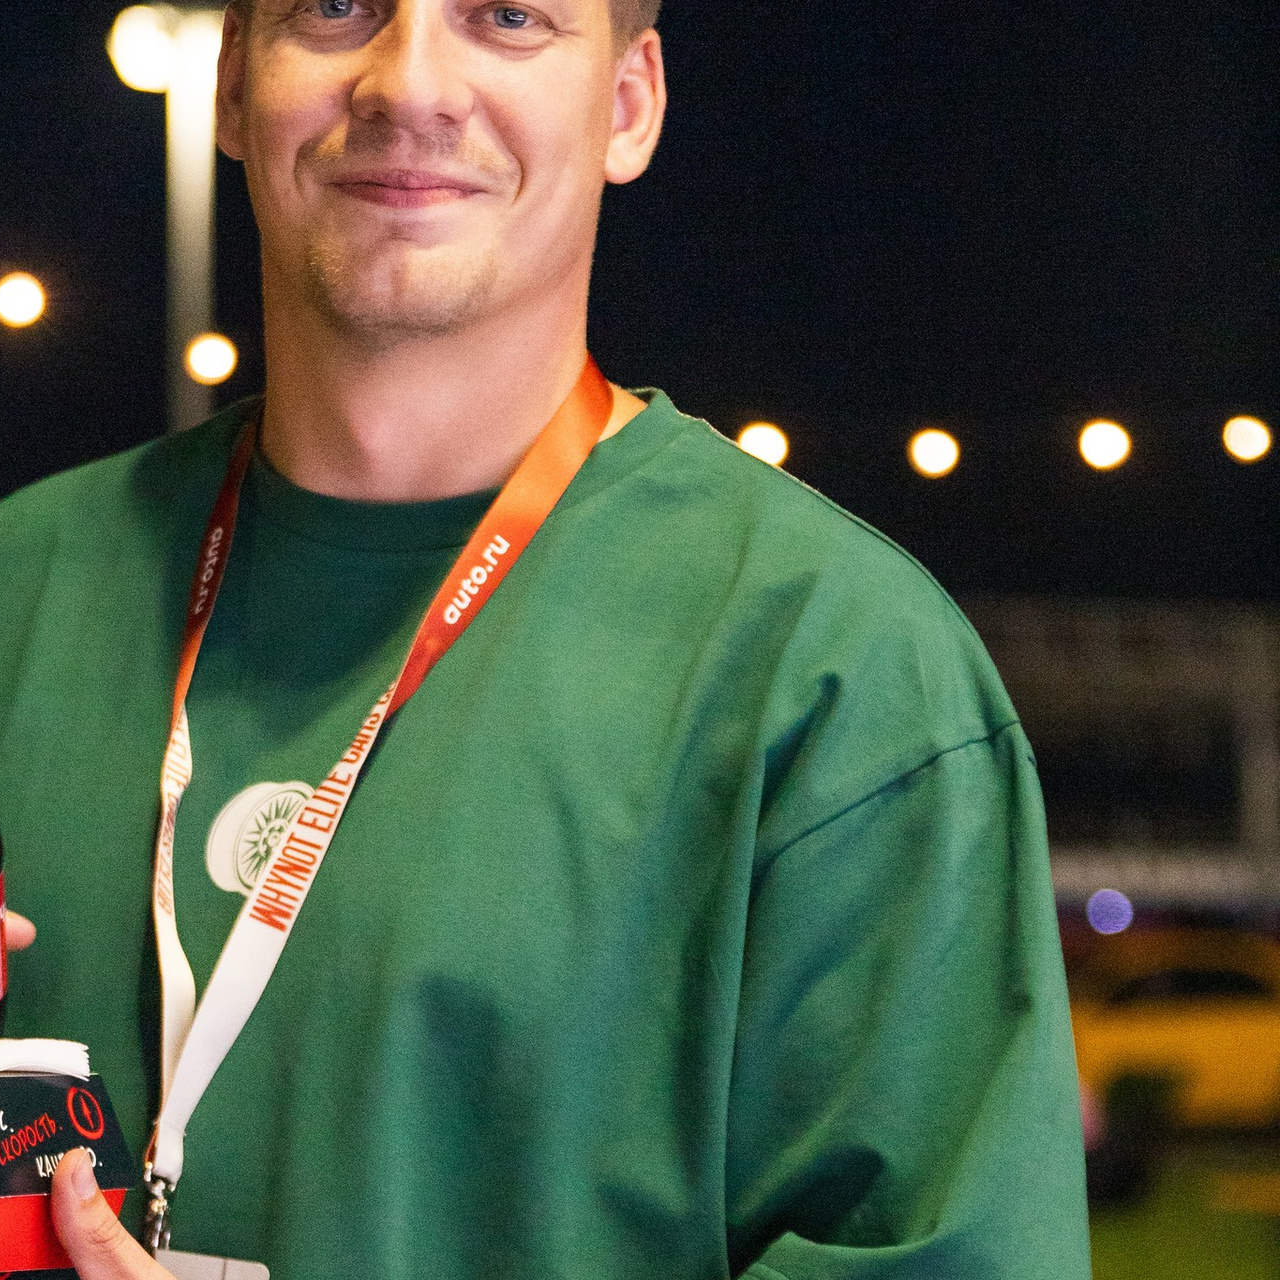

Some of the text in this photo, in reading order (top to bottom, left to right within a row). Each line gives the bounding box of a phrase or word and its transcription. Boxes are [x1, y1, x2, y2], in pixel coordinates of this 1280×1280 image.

[194, 527, 223, 615] auto.ru
[444, 534, 511, 625] auto.ru
[249, 831, 324, 933] WHYNOT
[297, 771, 353, 834] ELITE
